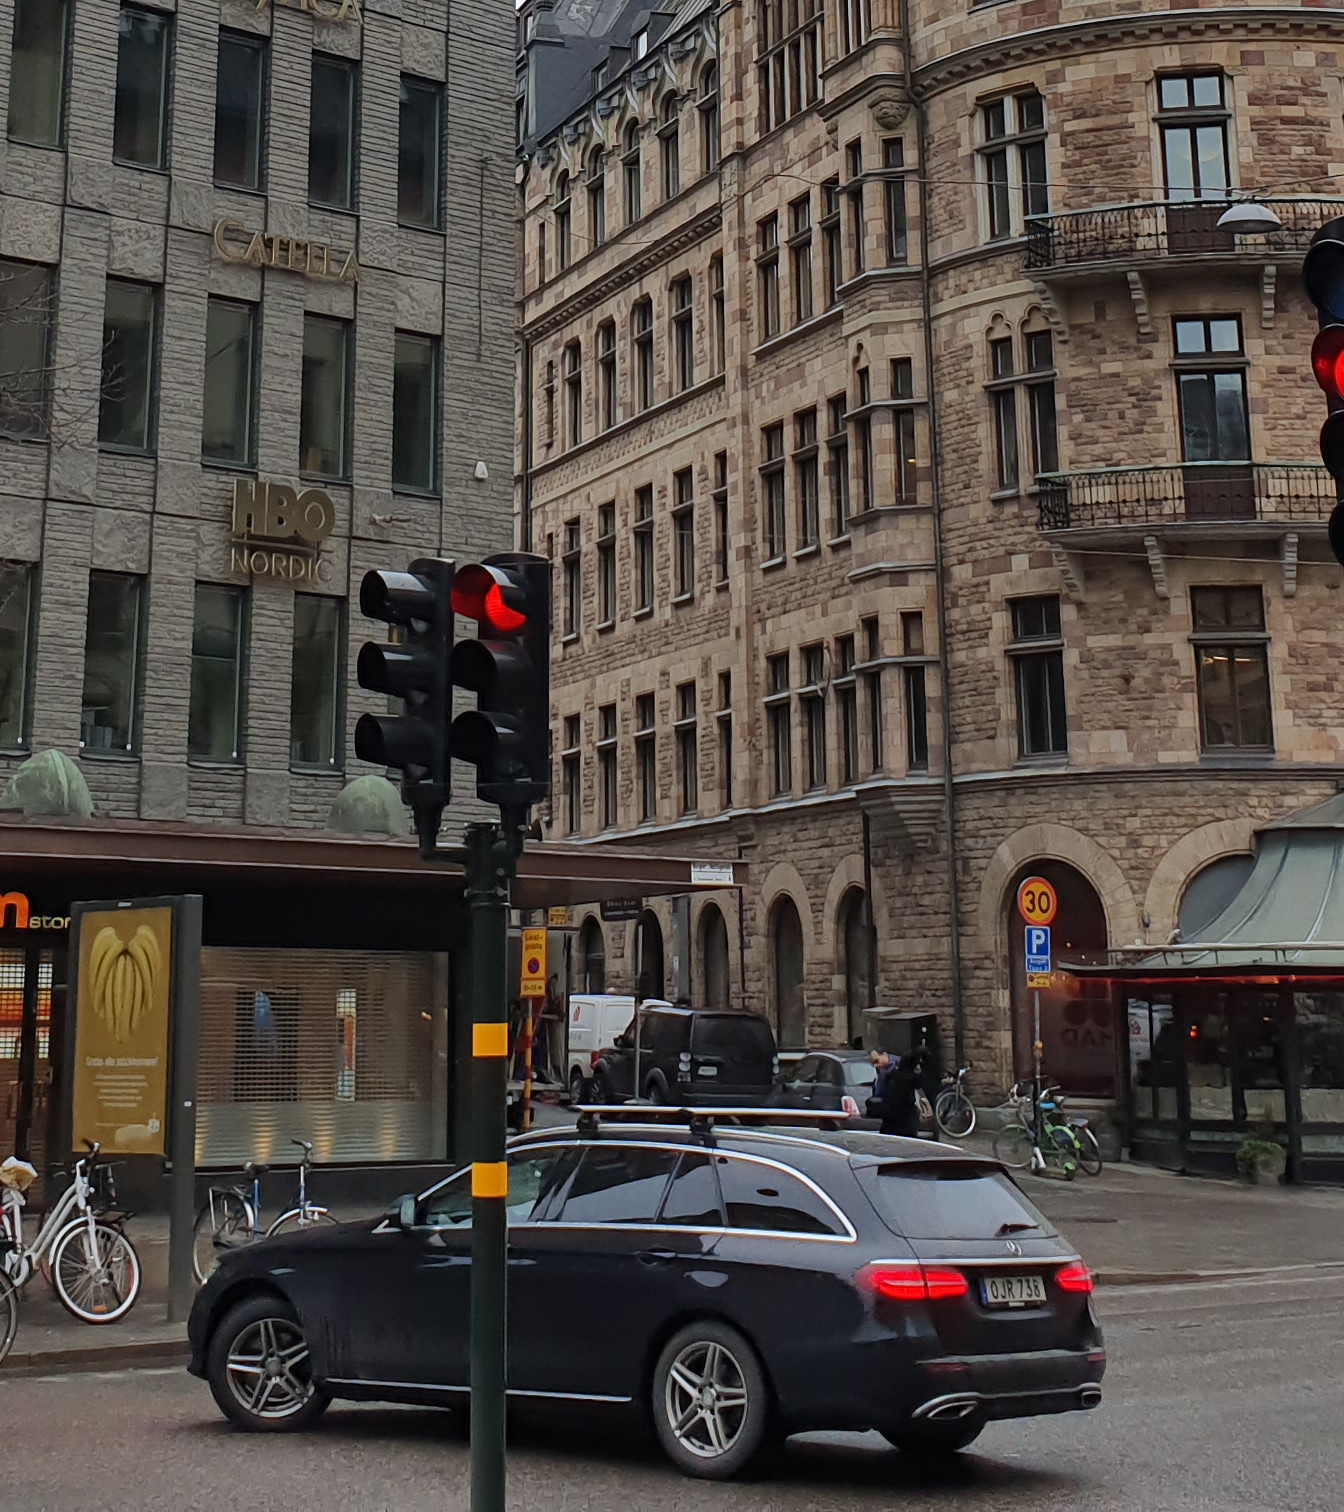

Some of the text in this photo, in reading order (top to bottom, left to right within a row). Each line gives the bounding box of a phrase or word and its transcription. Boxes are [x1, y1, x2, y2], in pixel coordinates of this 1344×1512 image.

[232, 476, 335, 542] HBO
[231, 546, 335, 583] NORDIC
[1025, 890, 1051, 914] 30
[1031, 929, 1046, 954] P
